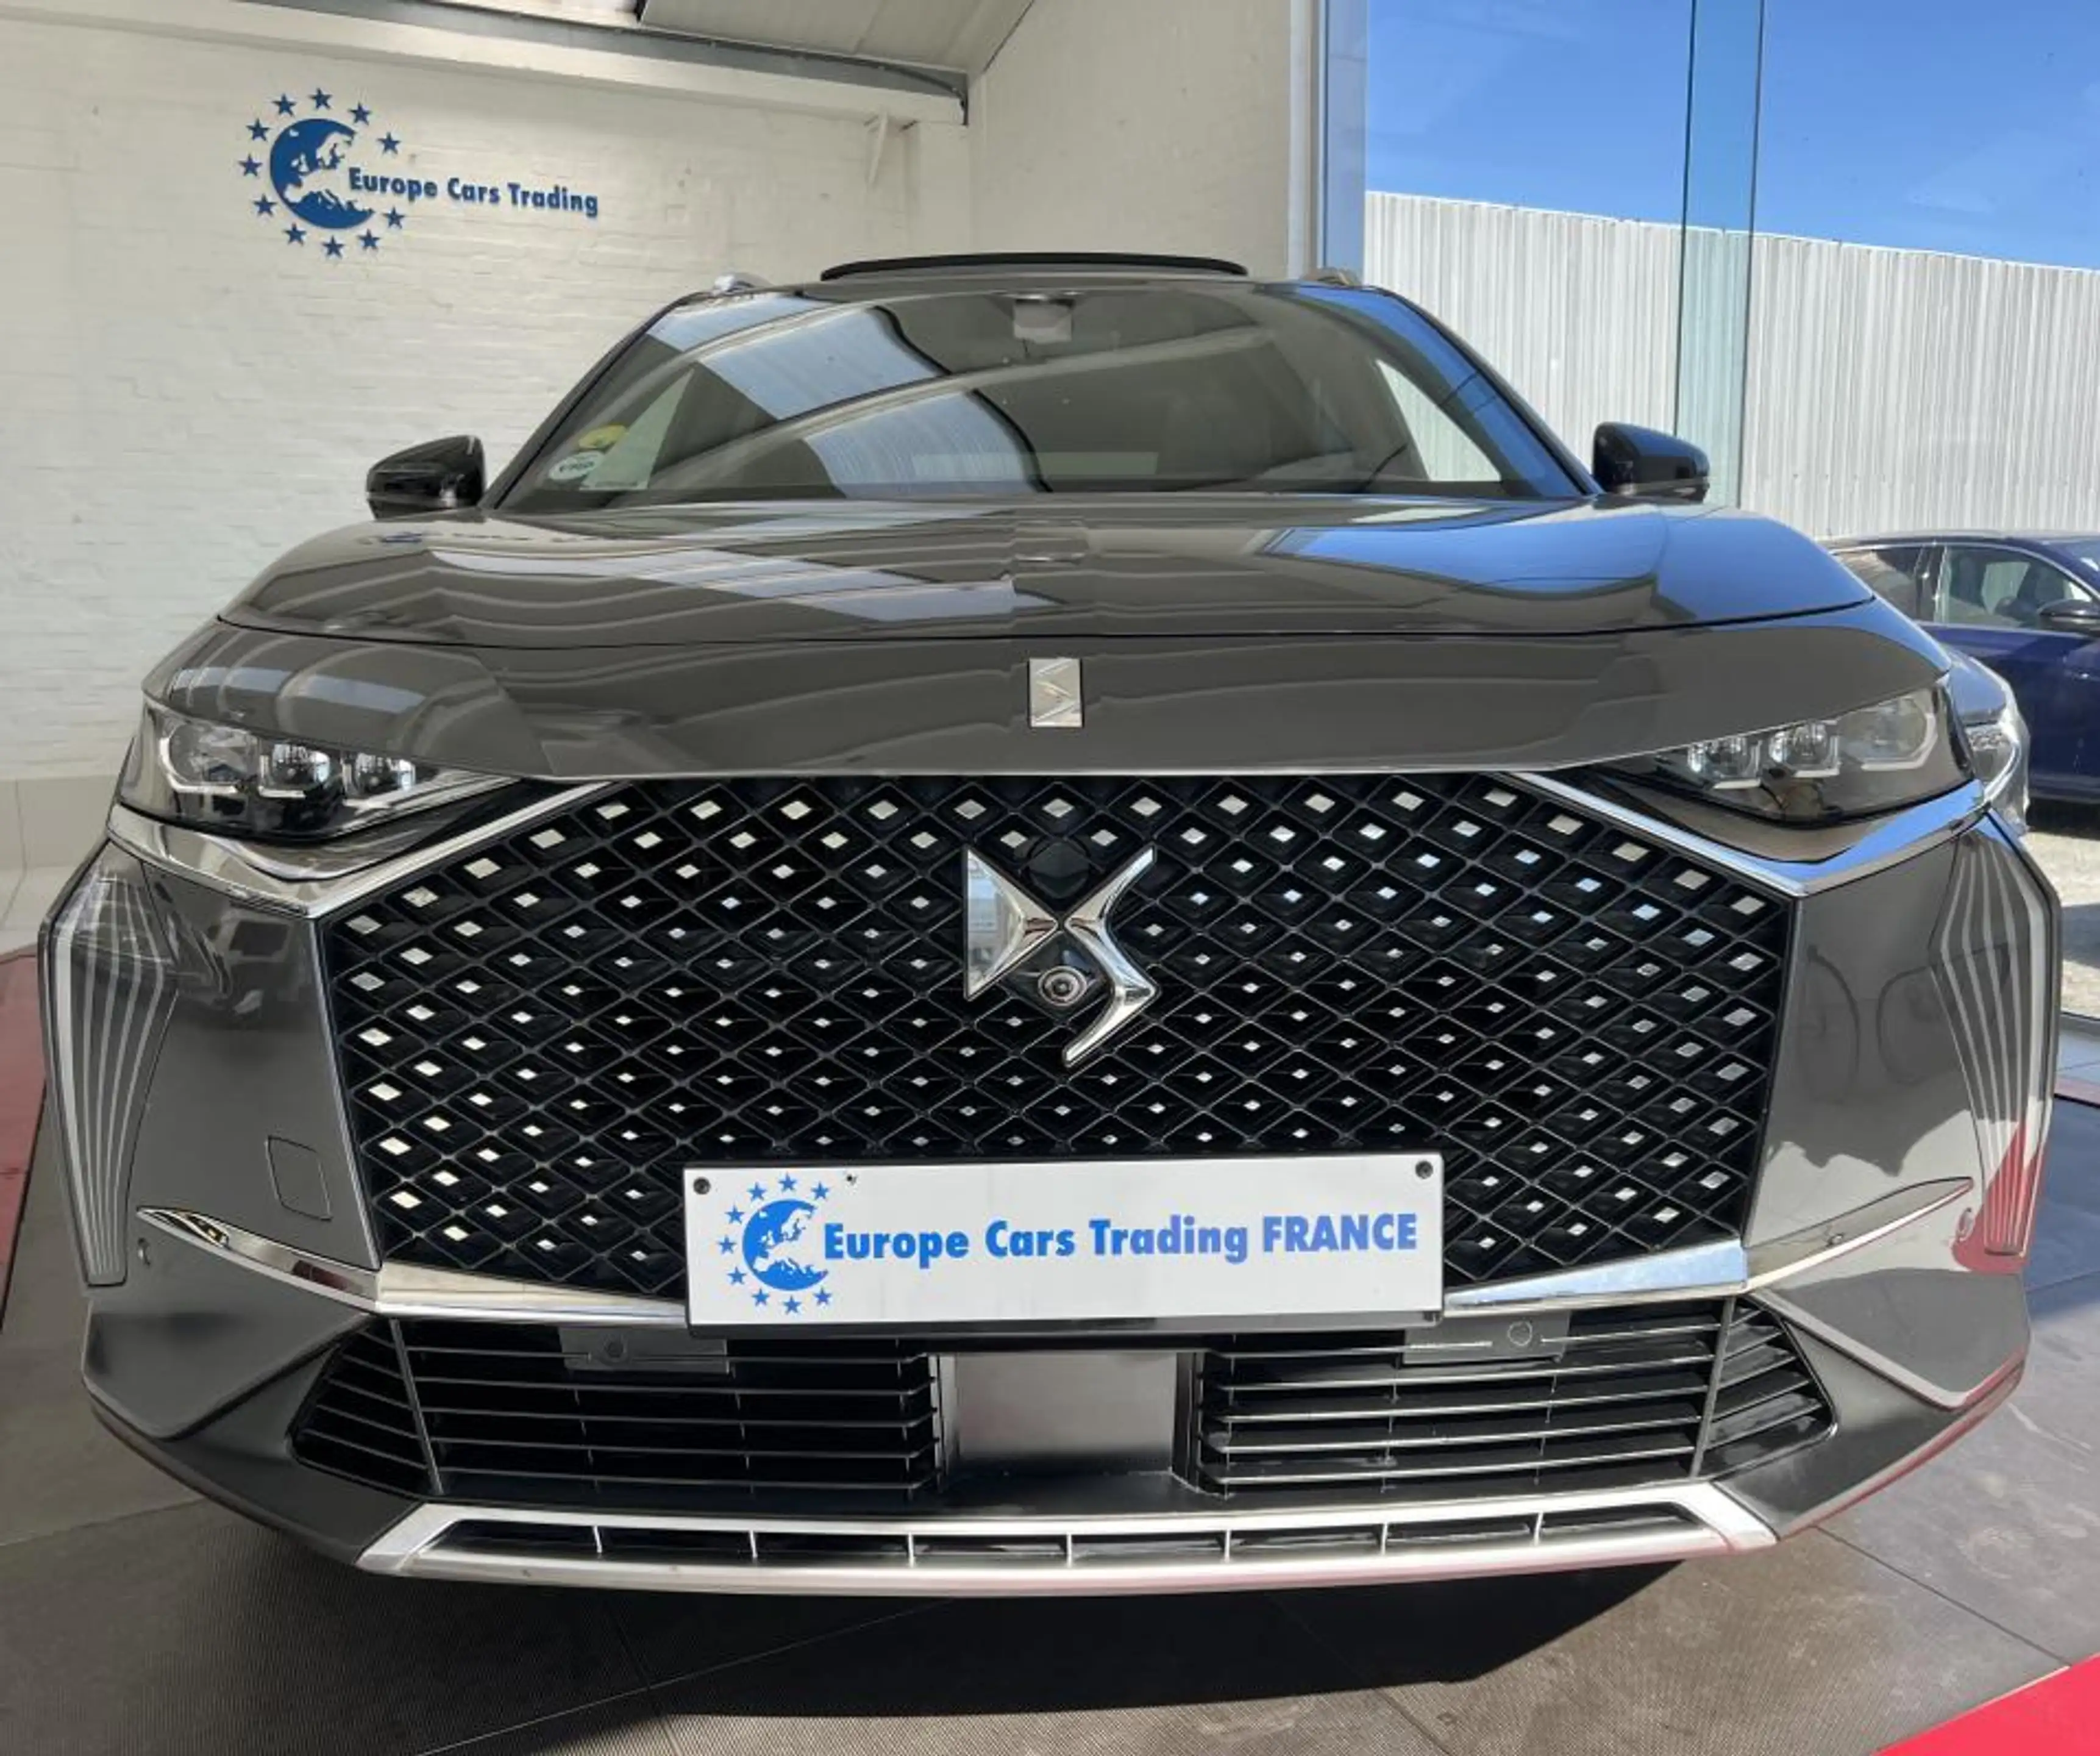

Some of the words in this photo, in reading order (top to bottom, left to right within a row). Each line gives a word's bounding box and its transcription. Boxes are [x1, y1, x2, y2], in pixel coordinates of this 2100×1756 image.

[348, 168, 438, 202] Europe
[447, 177, 500, 204] Cars
[507, 182, 599, 217] Trading
[823, 1222, 970, 1269] Europe
[984, 1219, 1077, 1259] Cars
[1089, 1214, 1248, 1265] Trading
[1263, 1212, 1417, 1254] FRANCE
